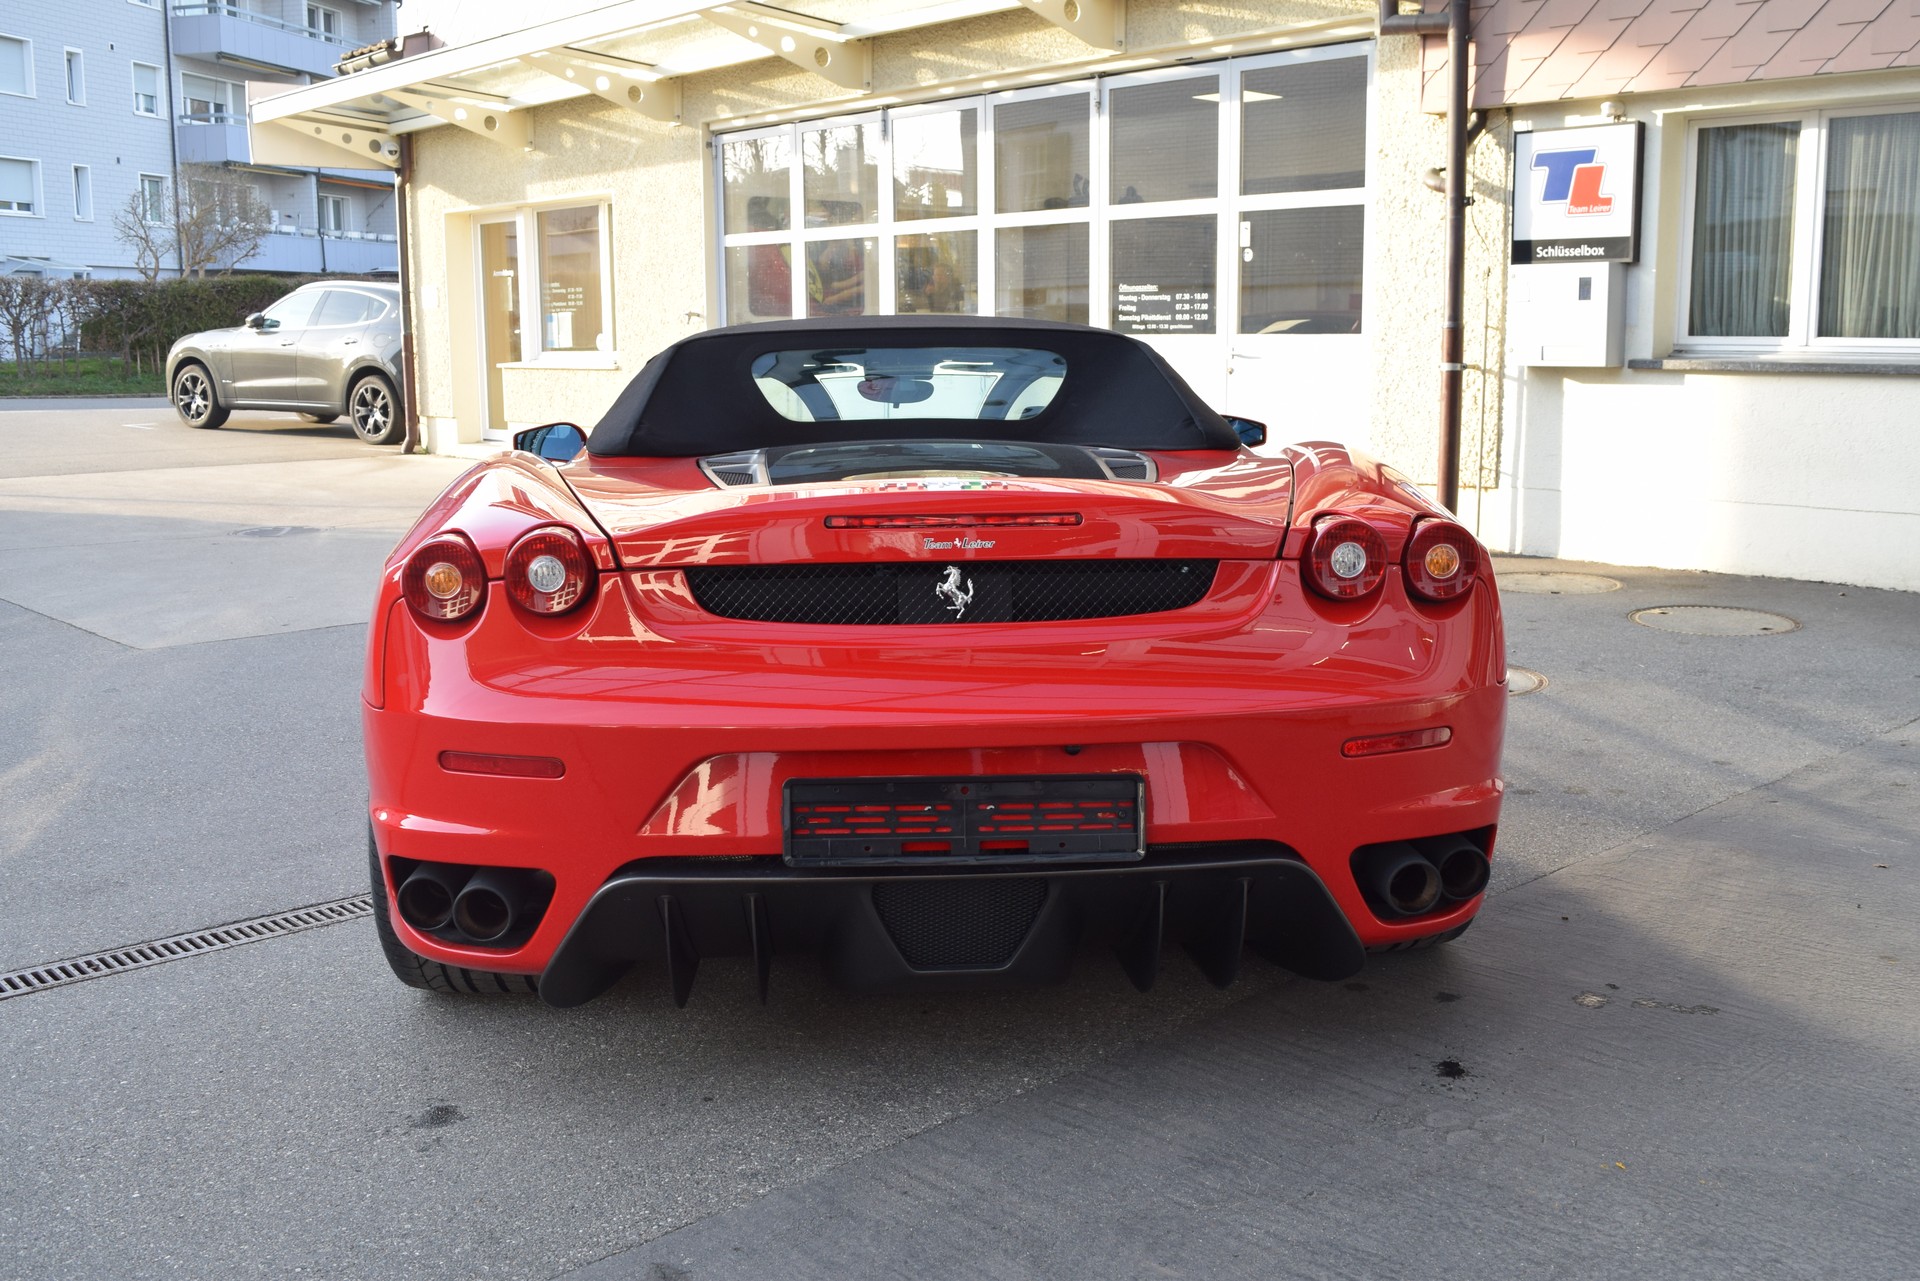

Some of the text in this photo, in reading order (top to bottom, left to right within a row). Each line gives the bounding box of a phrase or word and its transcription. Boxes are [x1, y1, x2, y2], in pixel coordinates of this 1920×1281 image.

[1532, 148, 1613, 215] TL
[1568, 204, 1611, 214] Team Leirer
[1535, 244, 1605, 258] Schlüsselbox
[1141, 294, 1171, 302] Donnerstag
[923, 537, 996, 549] Team Leirer
